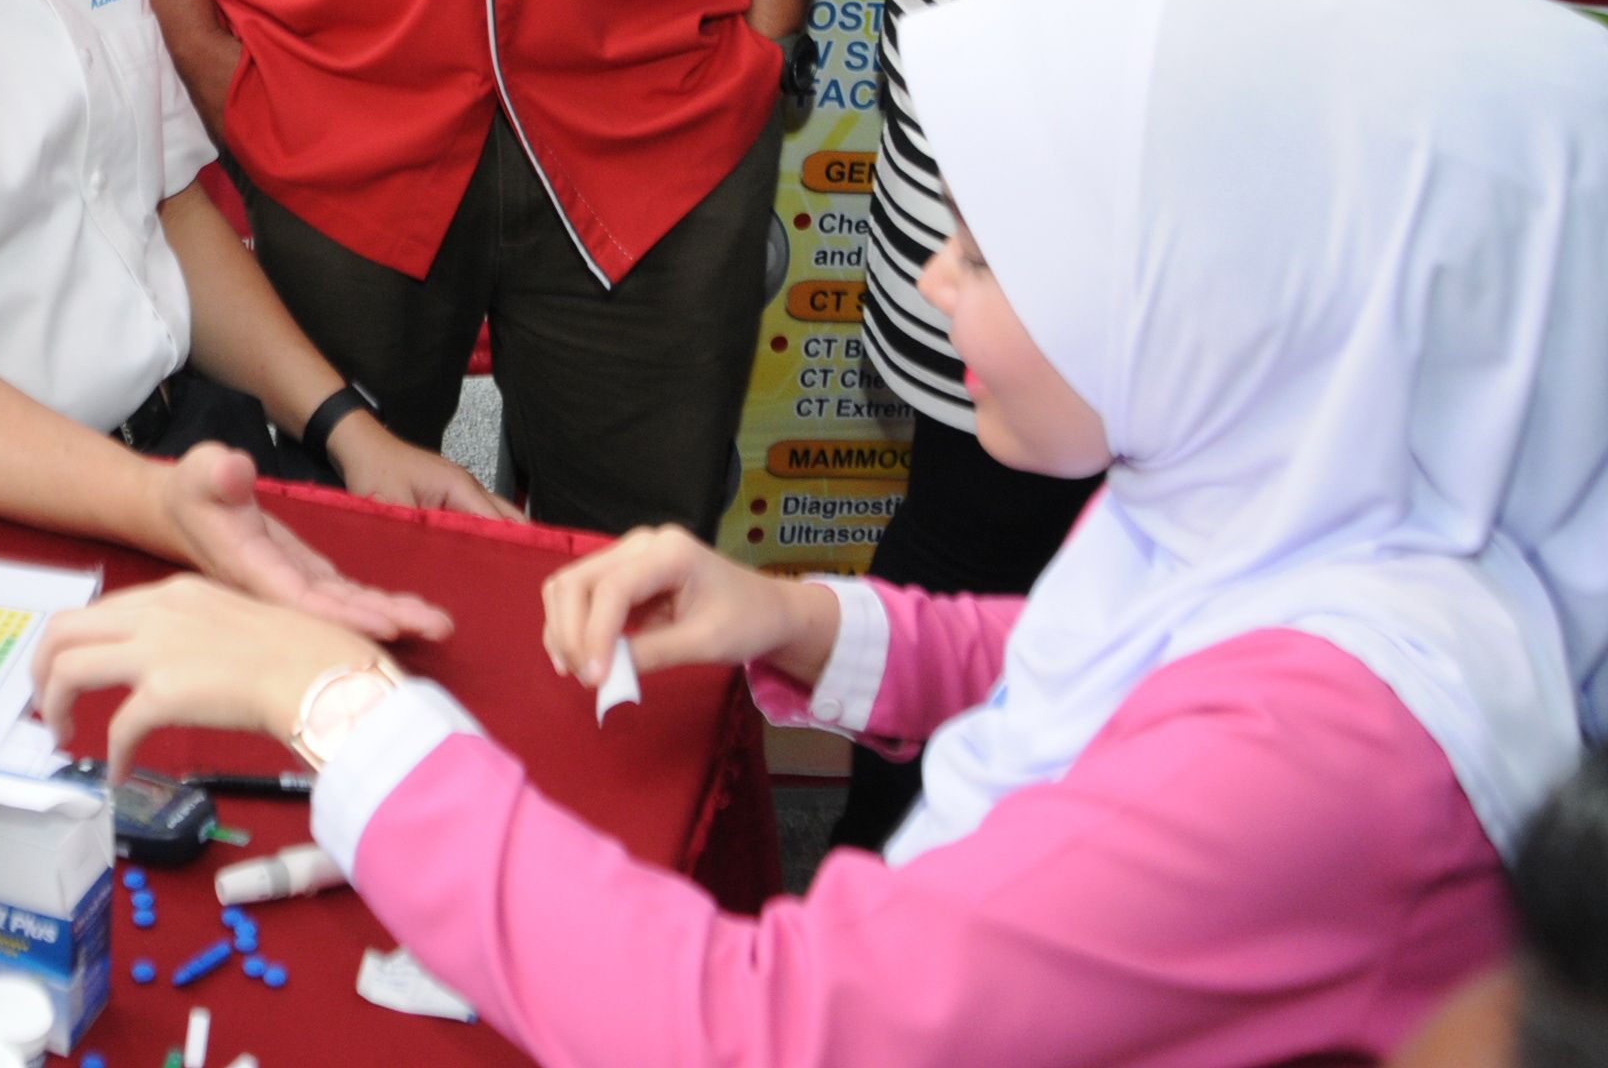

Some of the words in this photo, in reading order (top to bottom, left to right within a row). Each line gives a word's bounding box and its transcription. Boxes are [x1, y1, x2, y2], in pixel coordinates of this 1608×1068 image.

[814, 246, 863, 267] and
[809, 289, 848, 313] CT
[803, 337, 838, 359] CT
[800, 368, 834, 389] CT
[796, 398, 829, 418] CT
[9, 906, 58, 945] Plus
